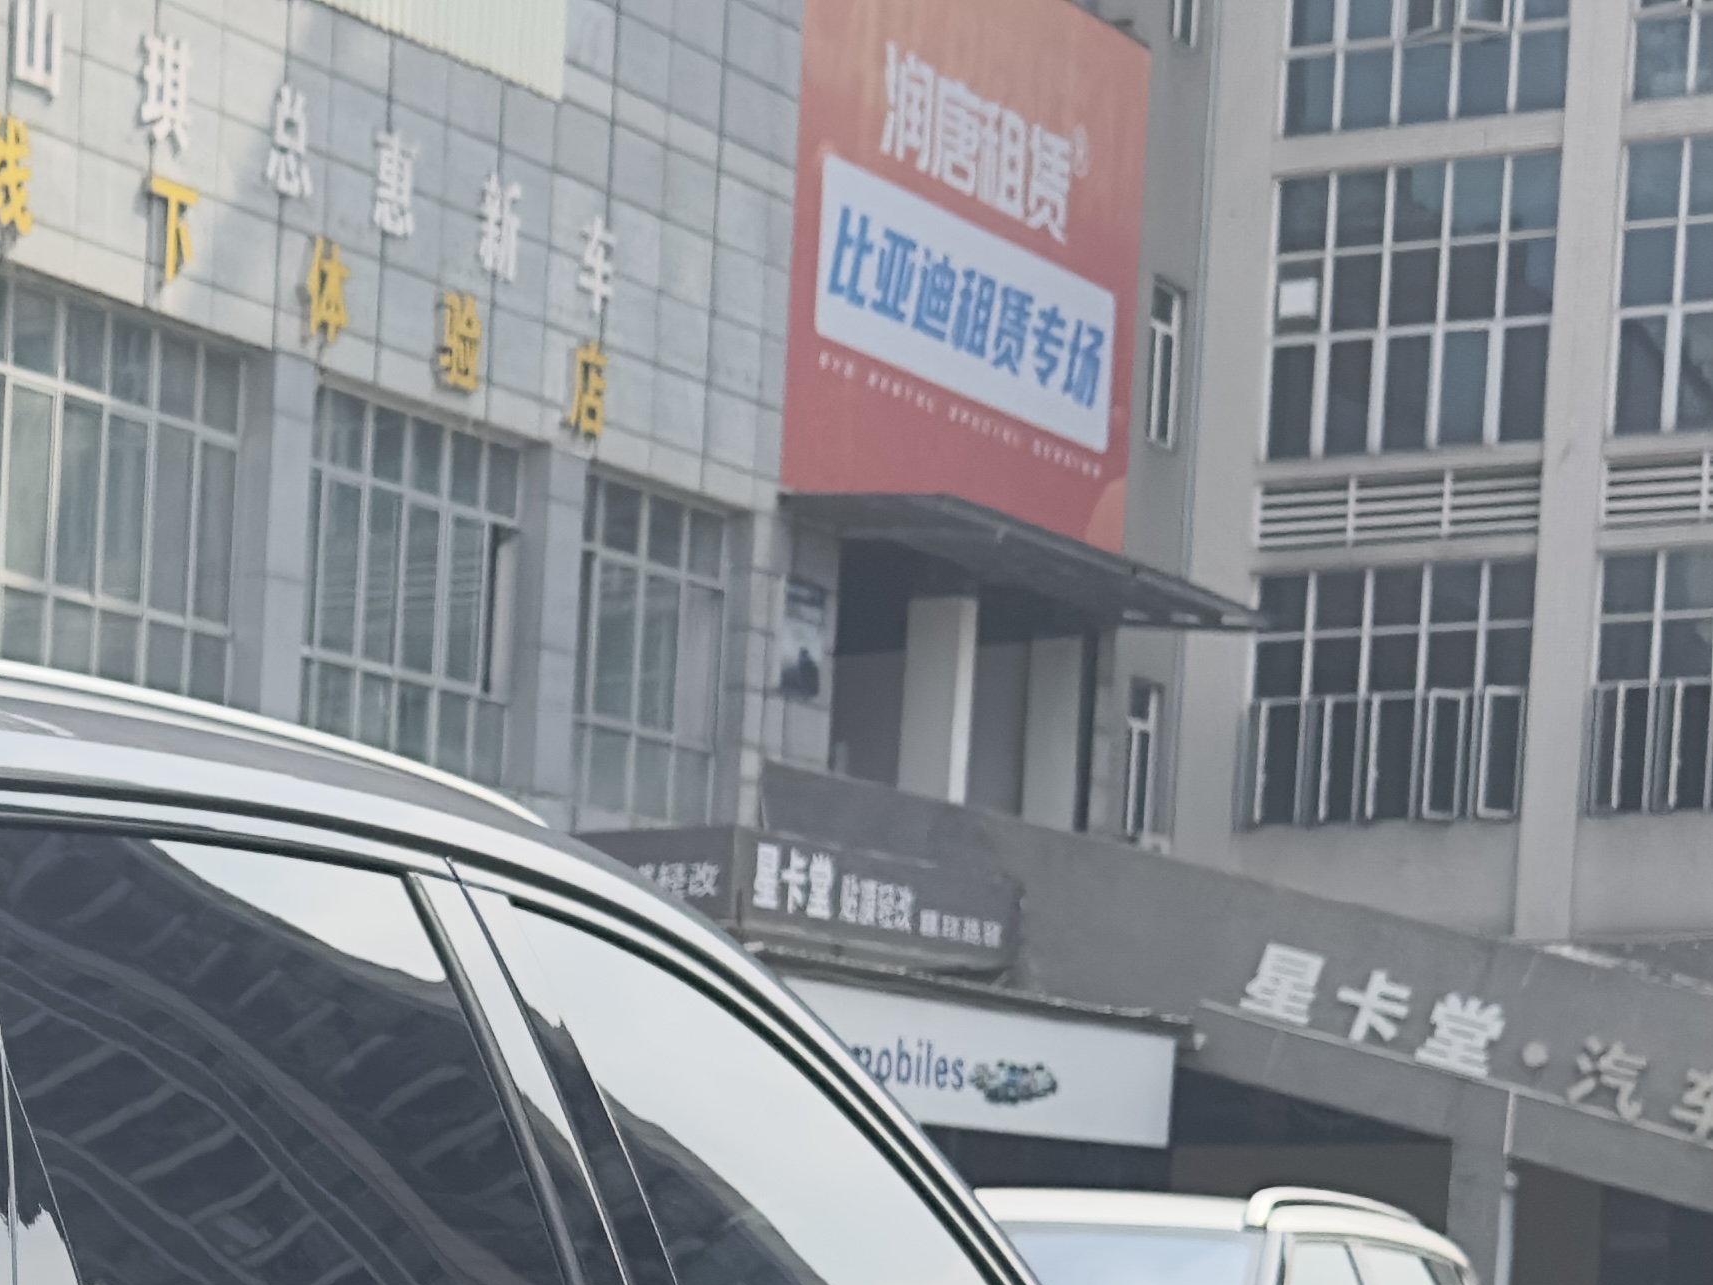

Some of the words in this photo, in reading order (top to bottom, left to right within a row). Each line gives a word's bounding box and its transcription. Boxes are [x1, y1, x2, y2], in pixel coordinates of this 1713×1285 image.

[827, 205, 1104, 410] 比亚迪租赁专场
